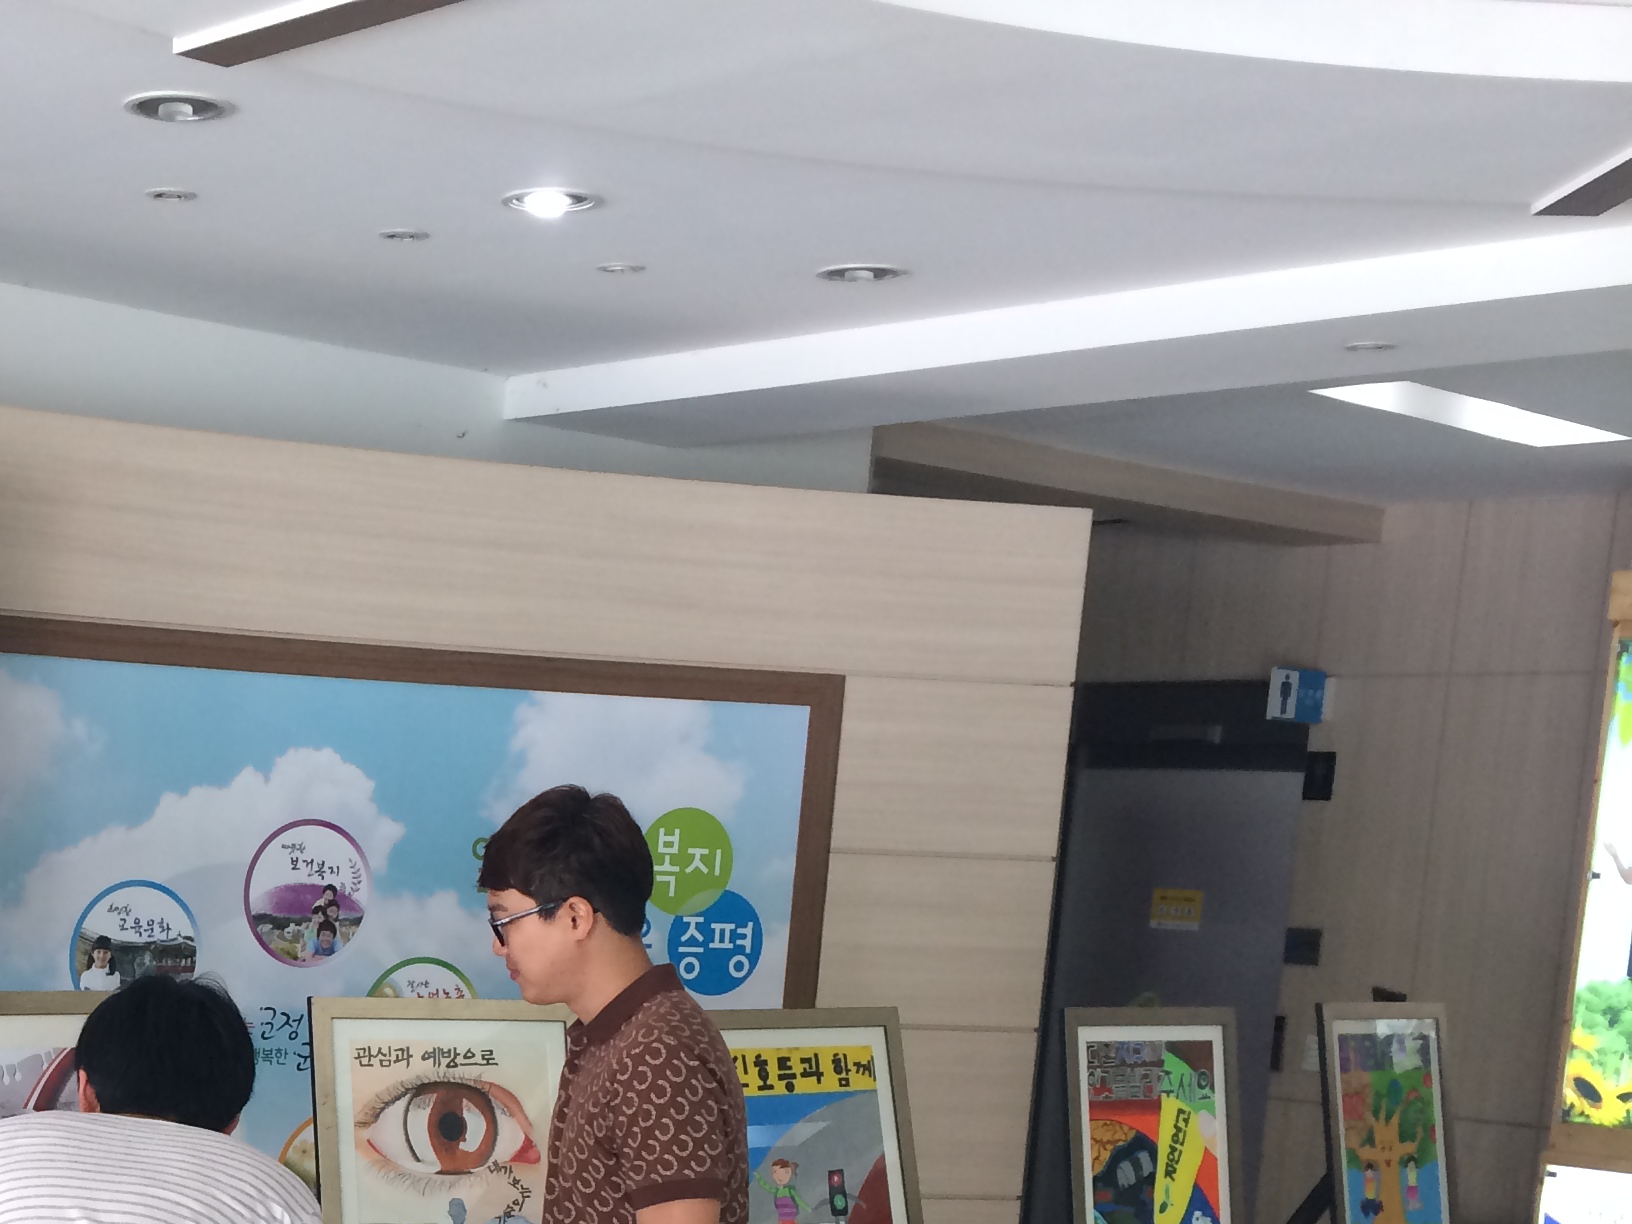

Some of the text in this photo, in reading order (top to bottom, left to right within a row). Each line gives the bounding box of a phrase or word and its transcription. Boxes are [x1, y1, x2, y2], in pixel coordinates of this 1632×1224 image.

[290, 856, 340, 880] 보건복지
[653, 827, 722, 897] 복지
[118, 917, 172, 939] 교육문화
[677, 916, 754, 980] 증평
[353, 1046, 499, 1068] 관심과 예방으로
[831, 1052, 877, 1088] 함께
[487, 1159, 514, 1180] 내가
[507, 1176, 532, 1198] 보는
[511, 1198, 526, 1212] 이
